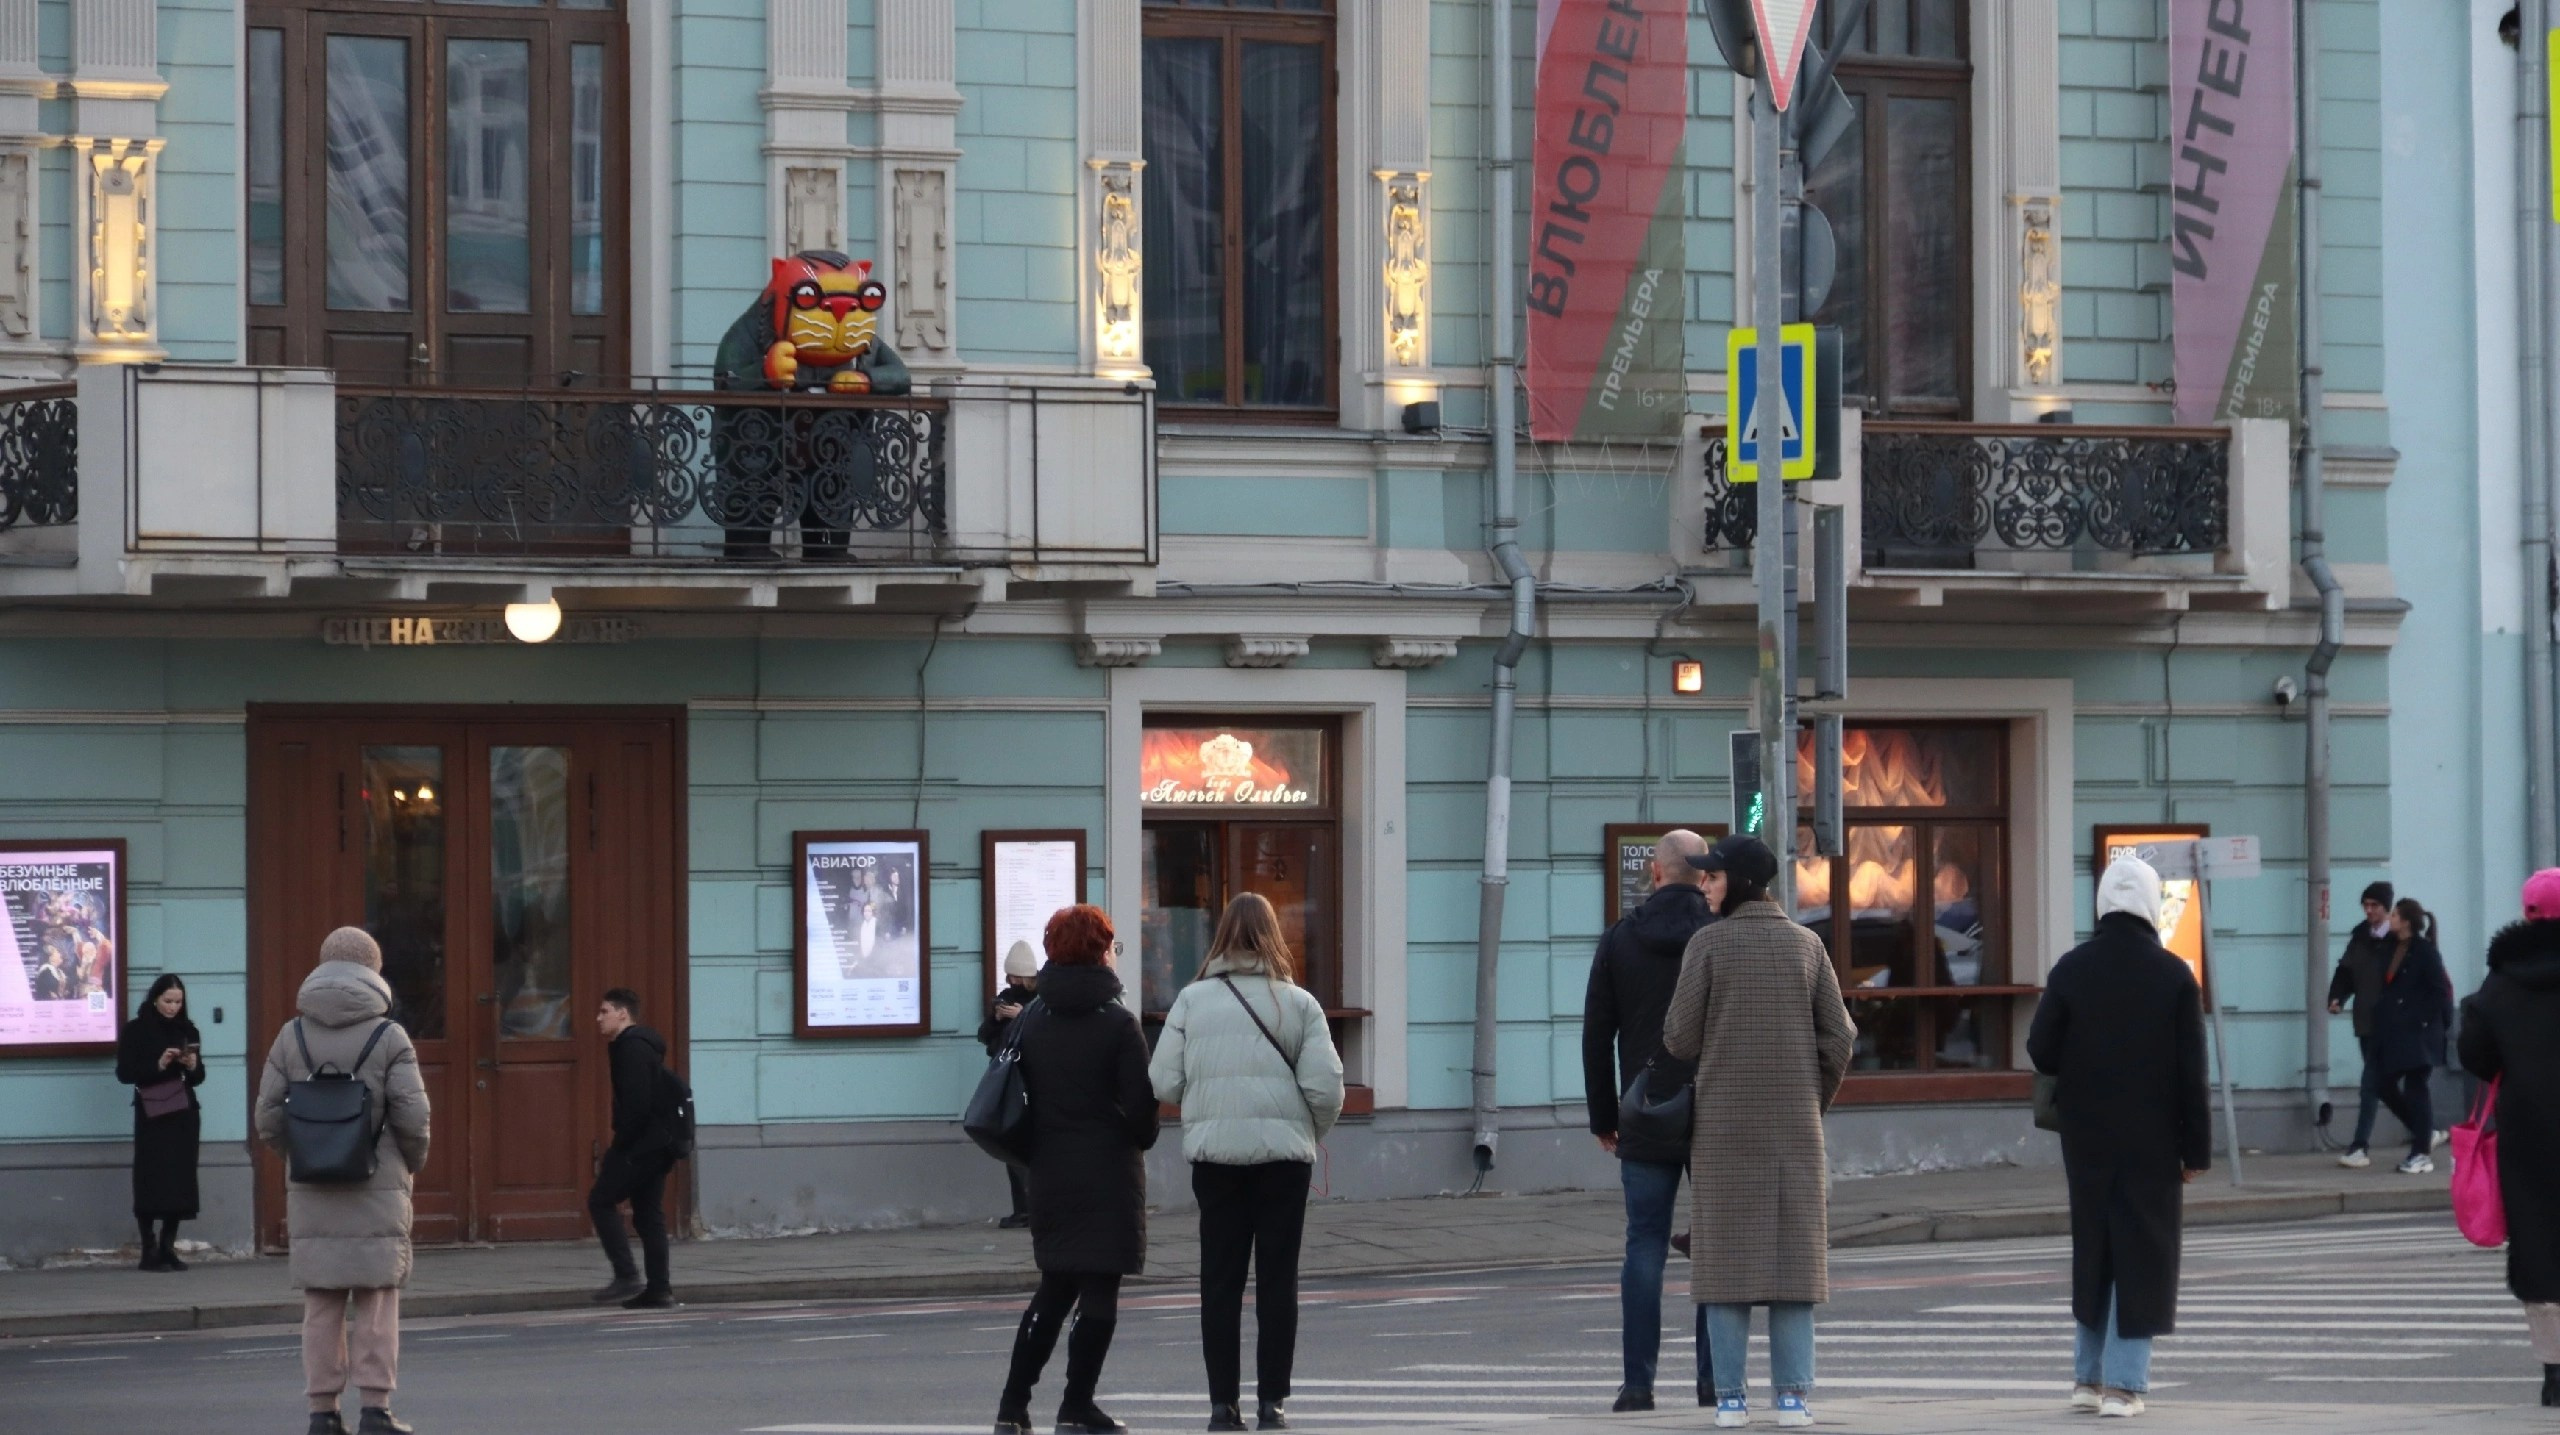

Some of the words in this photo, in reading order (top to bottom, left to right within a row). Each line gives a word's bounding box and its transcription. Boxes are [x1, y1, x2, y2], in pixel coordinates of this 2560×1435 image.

[1599, 268, 1663, 410] ПРЕМЬЕРА
[2226, 284, 2279, 418] ПРЕМЬЕРА
[1635, 388, 1664, 407] 16+
[2258, 397, 2282, 415] 18+
[323, 617, 435, 650] СЦЕНА
[0, 864, 78, 877] БЕЗУМНЫЕ
[812, 856, 876, 868] АВИАТОР
[1623, 859, 1645, 870] НЕТ
